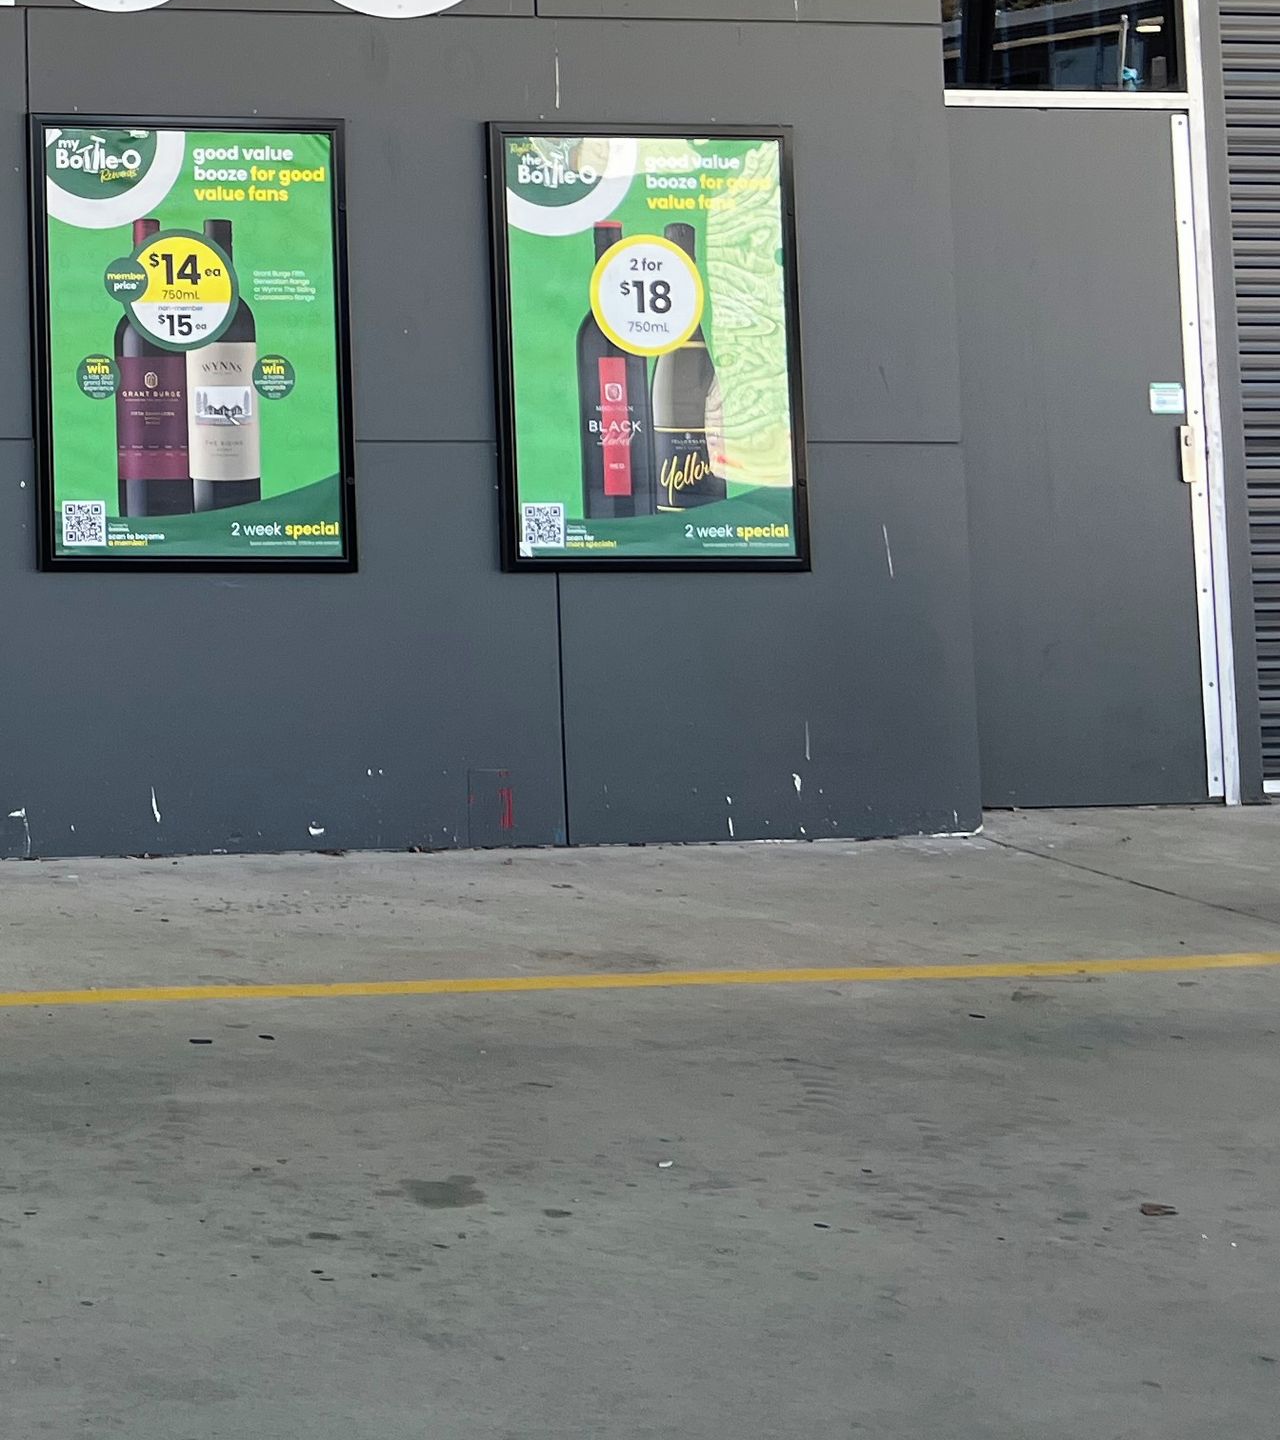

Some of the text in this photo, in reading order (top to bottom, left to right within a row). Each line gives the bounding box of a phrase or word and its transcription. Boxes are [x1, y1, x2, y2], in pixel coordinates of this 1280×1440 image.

[58, 139, 80, 152] my
[56, 135, 142, 174] Bottle-O
[192, 146, 294, 165] good value
[521, 154, 543, 167] the
[517, 152, 597, 189] Bottle-O
[643, 154, 740, 173] good value
[194, 165, 325, 186] booze for good
[646, 174, 697, 190] booze
[700, 174, 722, 190] for
[194, 186, 289, 202] value fans
[646, 194, 696, 210] value
[149, 252, 221, 286] $14 ea
[630, 258, 663, 271] 2 for
[107, 273, 146, 281] member
[161, 289, 200, 300] 750mL
[619, 280, 672, 314] $18
[158, 314, 193, 337] $15
[627, 321, 670, 333] 750mL
[86, 362, 110, 374] win
[262, 362, 285, 375] win
[122, 390, 150, 398] GRANT
[588, 420, 642, 433] BLACK
[231, 521, 340, 540] 2 week special
[685, 523, 790, 542] 2 week special
